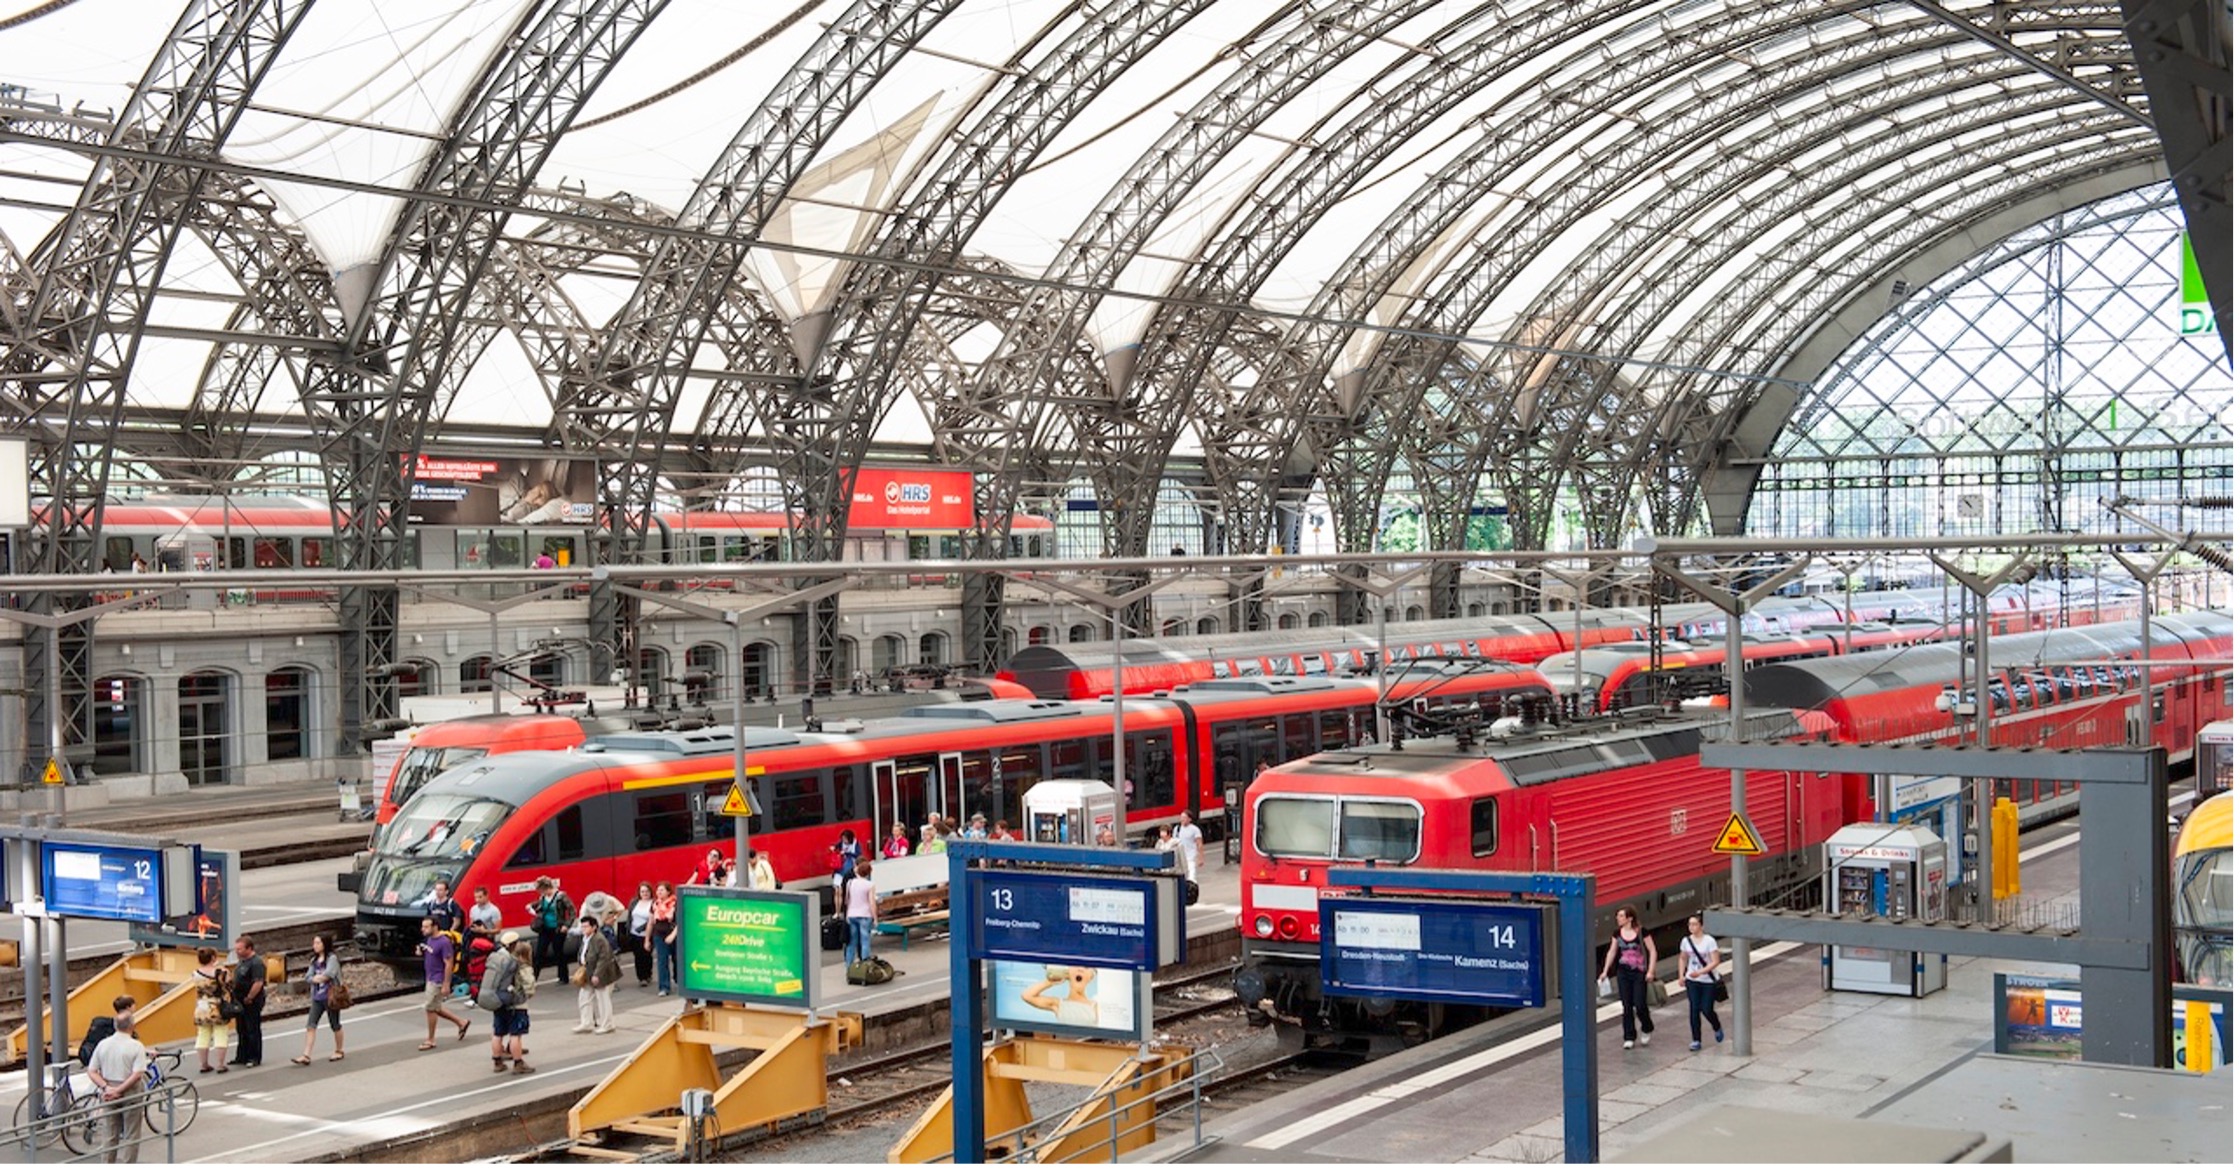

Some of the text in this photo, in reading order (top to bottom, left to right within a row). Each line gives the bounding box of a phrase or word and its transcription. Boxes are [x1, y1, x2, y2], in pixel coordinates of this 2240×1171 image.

[902, 485, 930, 501] HRS
[572, 505, 594, 515] HRS
[993, 757, 1000, 772] 2
[134, 860, 150, 880] 12
[991, 888, 1013, 910] 13
[706, 905, 779, 928] Europcar
[1081, 923, 1118, 936] Zwickau
[1489, 925, 1515, 949] 14
[1455, 955, 1497, 969] Kamenz
